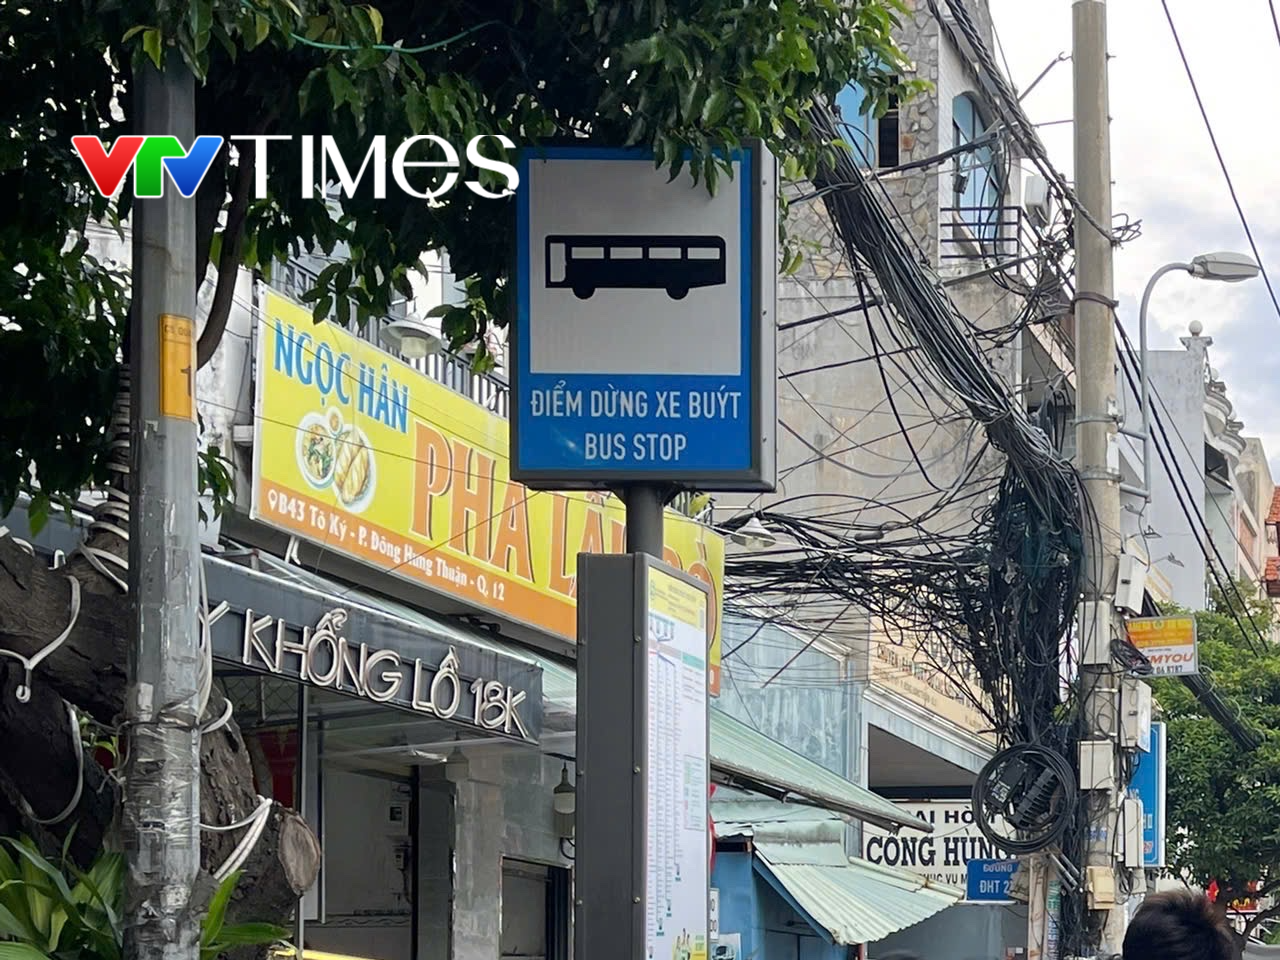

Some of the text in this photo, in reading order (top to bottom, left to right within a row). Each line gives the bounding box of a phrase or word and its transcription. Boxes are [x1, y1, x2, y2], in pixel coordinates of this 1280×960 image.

[275, 319, 408, 433] NGỌC HÂN
[530, 380, 741, 419] ĐIỂM DỪNG XE BUÝT
[585, 433, 686, 461] BUS STOP
[278, 493, 305, 522] B43
[330, 517, 347, 541] Ký
[358, 528, 368, 547] P.
[371, 534, 401, 565] Đông
[492, 582, 505, 600] 12
[243, 608, 402, 702] KHỔNG
[470, 677, 529, 739] 18K
[979, 880, 1000, 894] ĐHT
